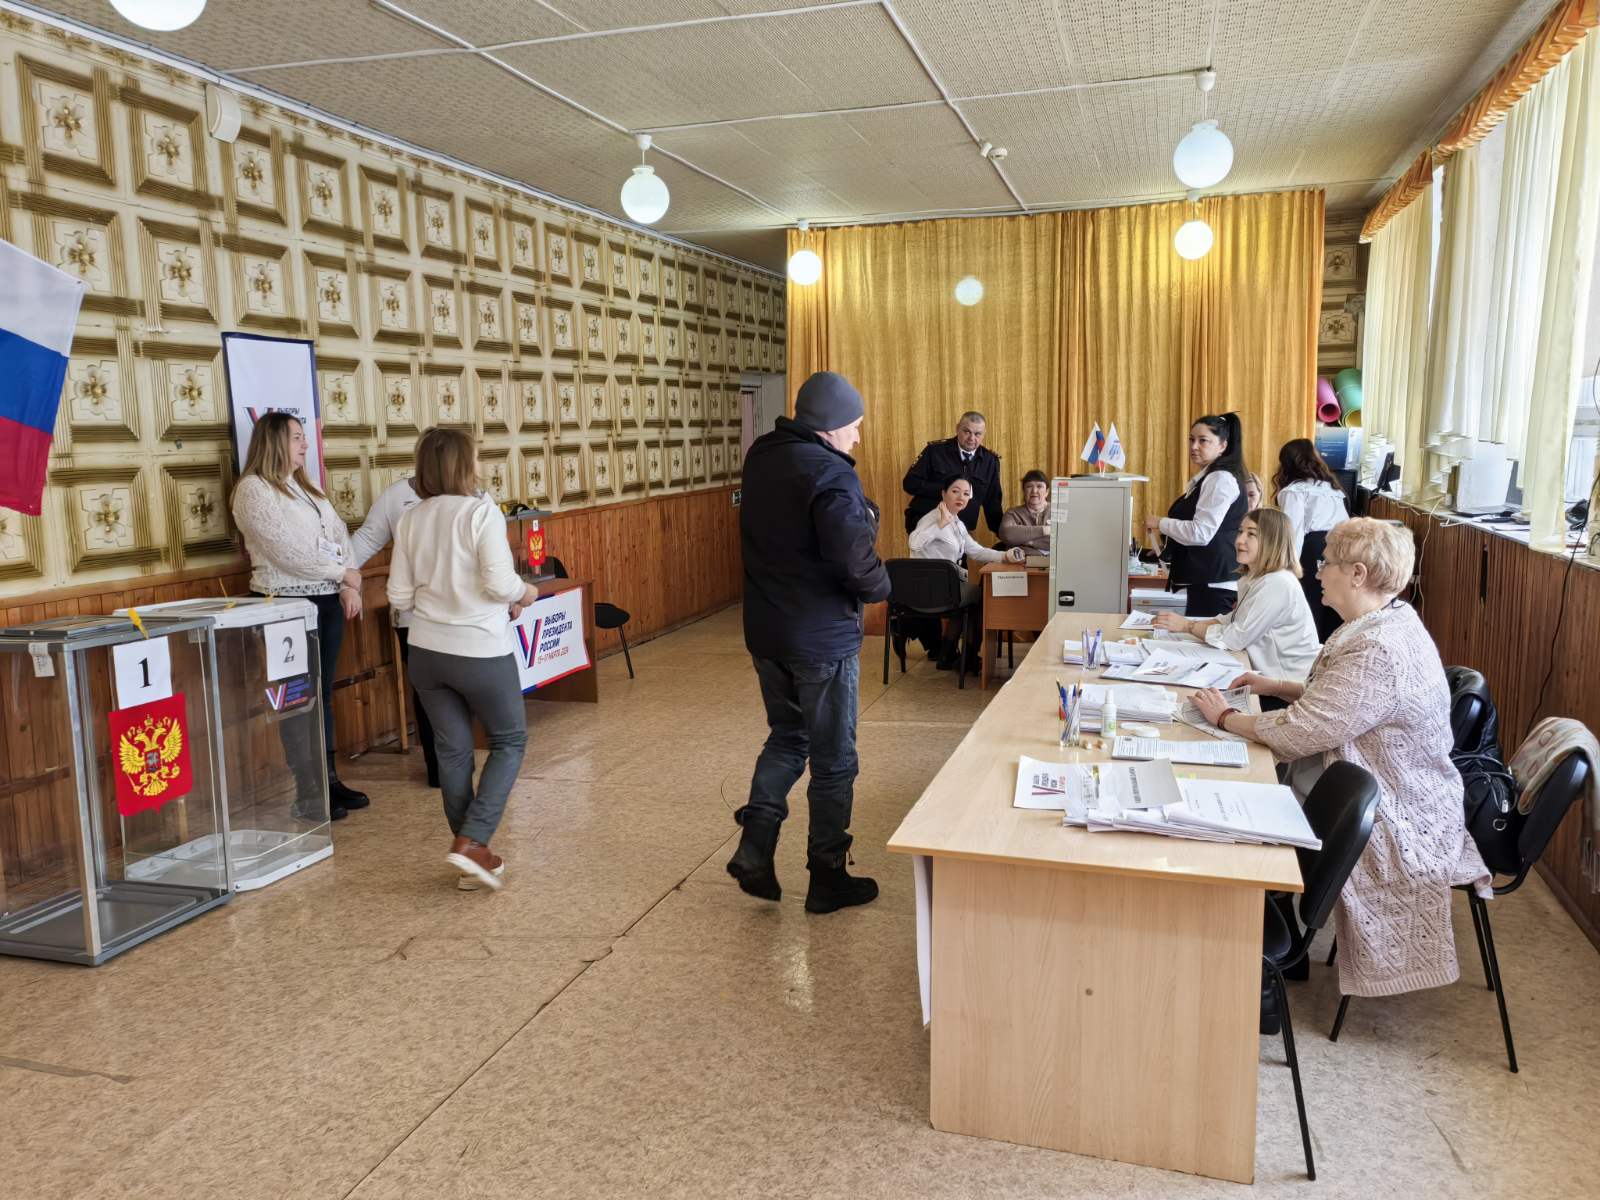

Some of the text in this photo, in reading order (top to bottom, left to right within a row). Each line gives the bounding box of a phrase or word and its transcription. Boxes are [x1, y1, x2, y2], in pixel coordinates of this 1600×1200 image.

[544, 611, 566, 626] ВЫБОРЫ
[541, 620, 573, 639] ПРЕЗИДЕНТА
[282, 636, 295, 663] 2
[540, 637, 561, 653] РОССИИ
[138, 657, 152, 688] 1
